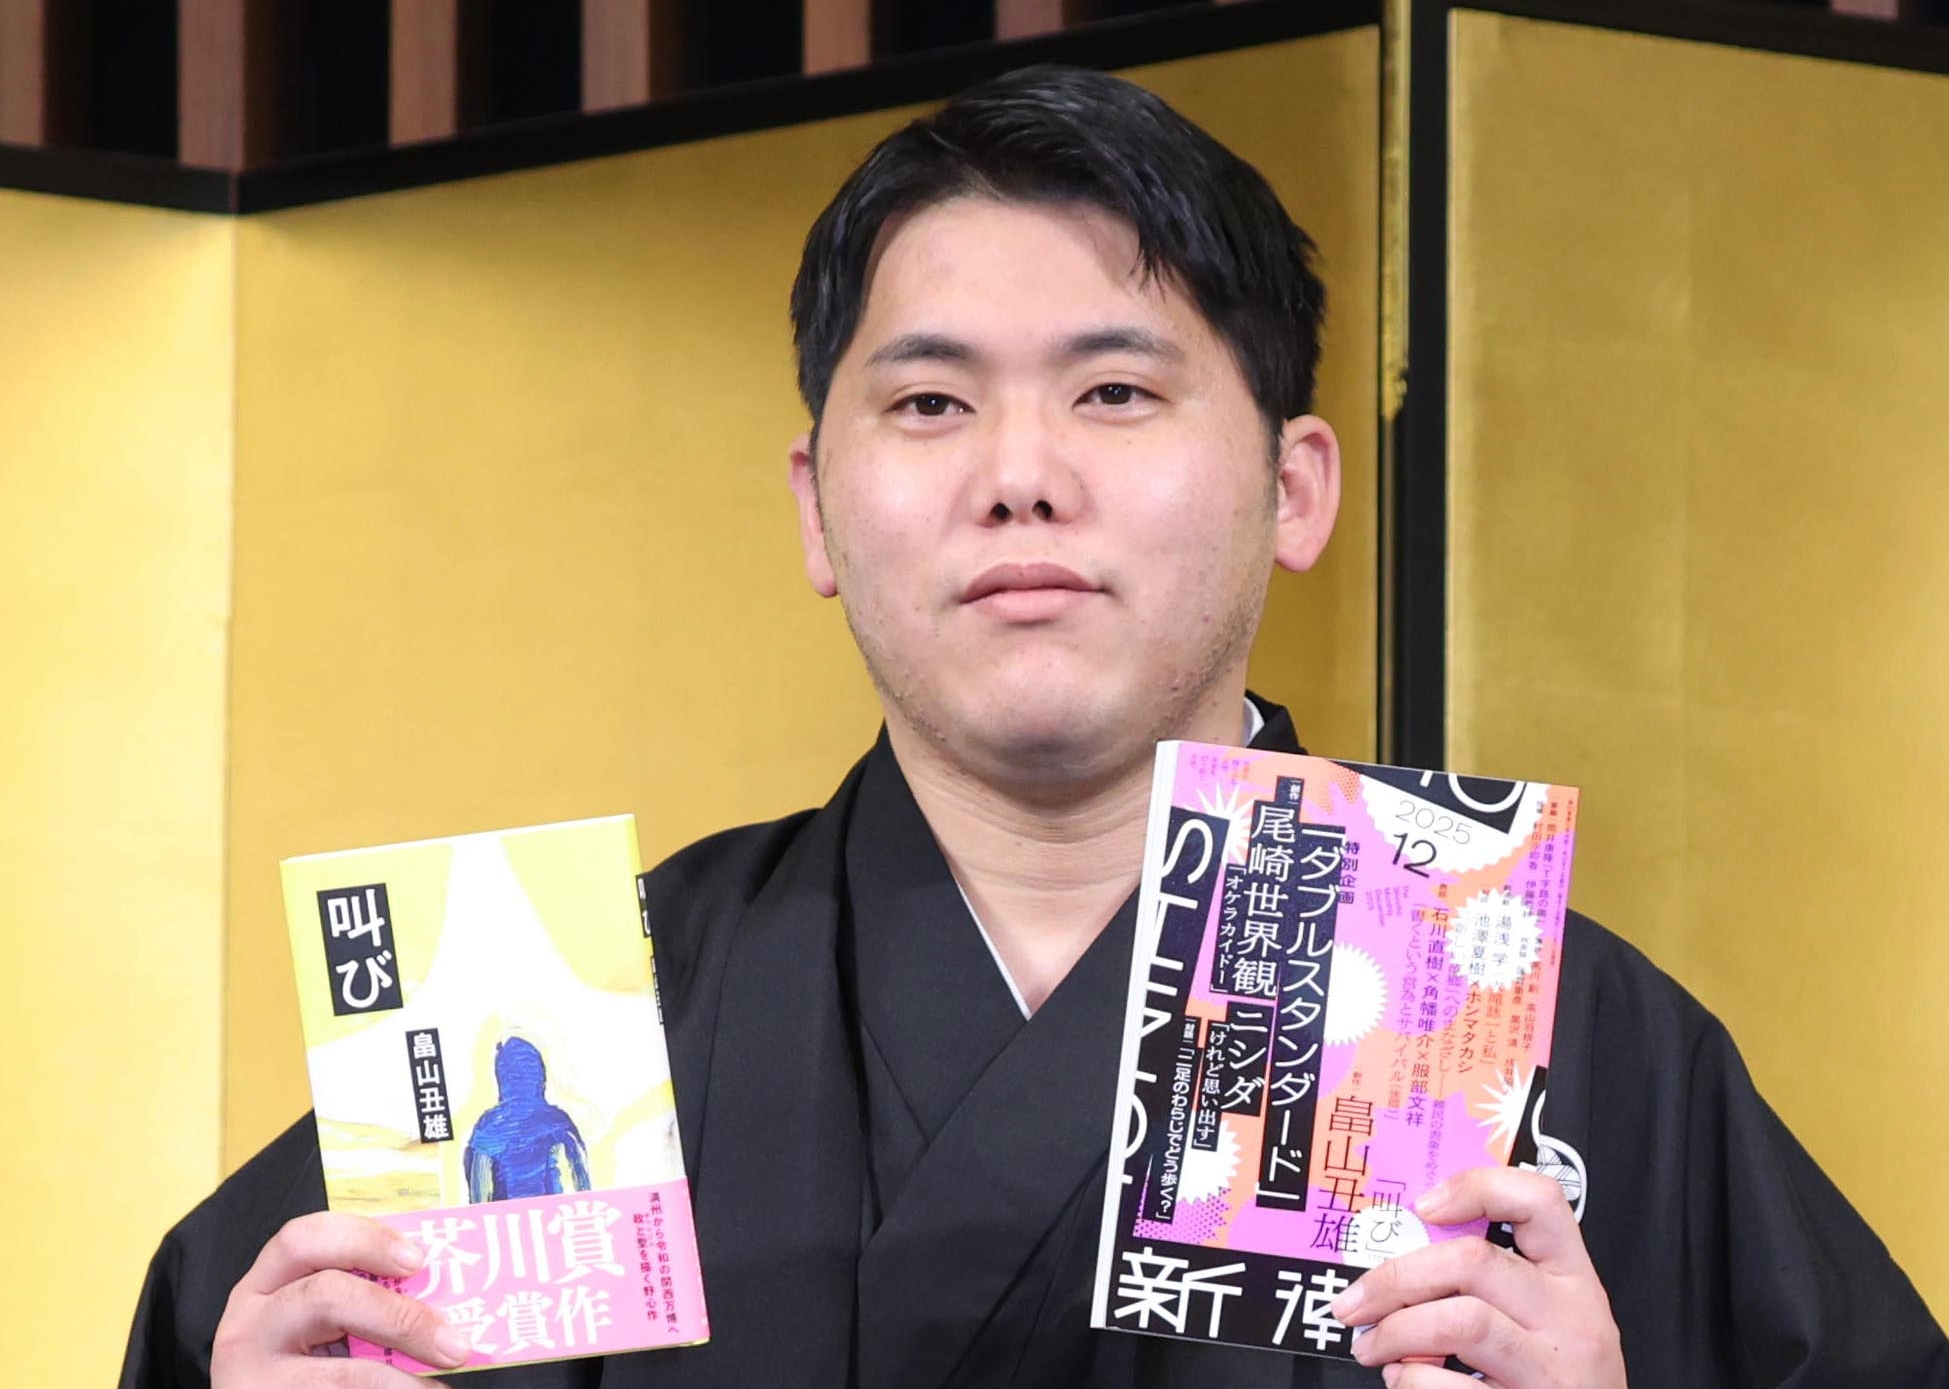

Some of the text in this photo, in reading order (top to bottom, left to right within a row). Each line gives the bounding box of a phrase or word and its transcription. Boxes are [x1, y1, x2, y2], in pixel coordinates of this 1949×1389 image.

[1339, 840, 1361, 905] 特別企画
[1391, 832, 1437, 879] 12
[1395, 799, 1473, 846] 2025
[327, 888, 394, 1009] 叫び
[1209, 866, 1247, 994] 「オケラカイドー」
[1232, 805, 1296, 996] 尾崎世界観
[1220, 1010, 1271, 1111] ニシダ
[1256, 828, 1346, 1200] 「ダブルスタンダード」
[1405, 907, 1449, 1129] 石川直樹×角幡唯介×服部文祥
[412, 1032, 450, 1140] 畠山丑雄
[1192, 1021, 1231, 1149] 「けれど思い出す」
[1309, 1095, 1374, 1254] 畠山丑雄
[1365, 1178, 1407, 1254] 「叫び」
[405, 1199, 626, 1300] 芥川賞
[440, 1285, 613, 1355] 受賞作
